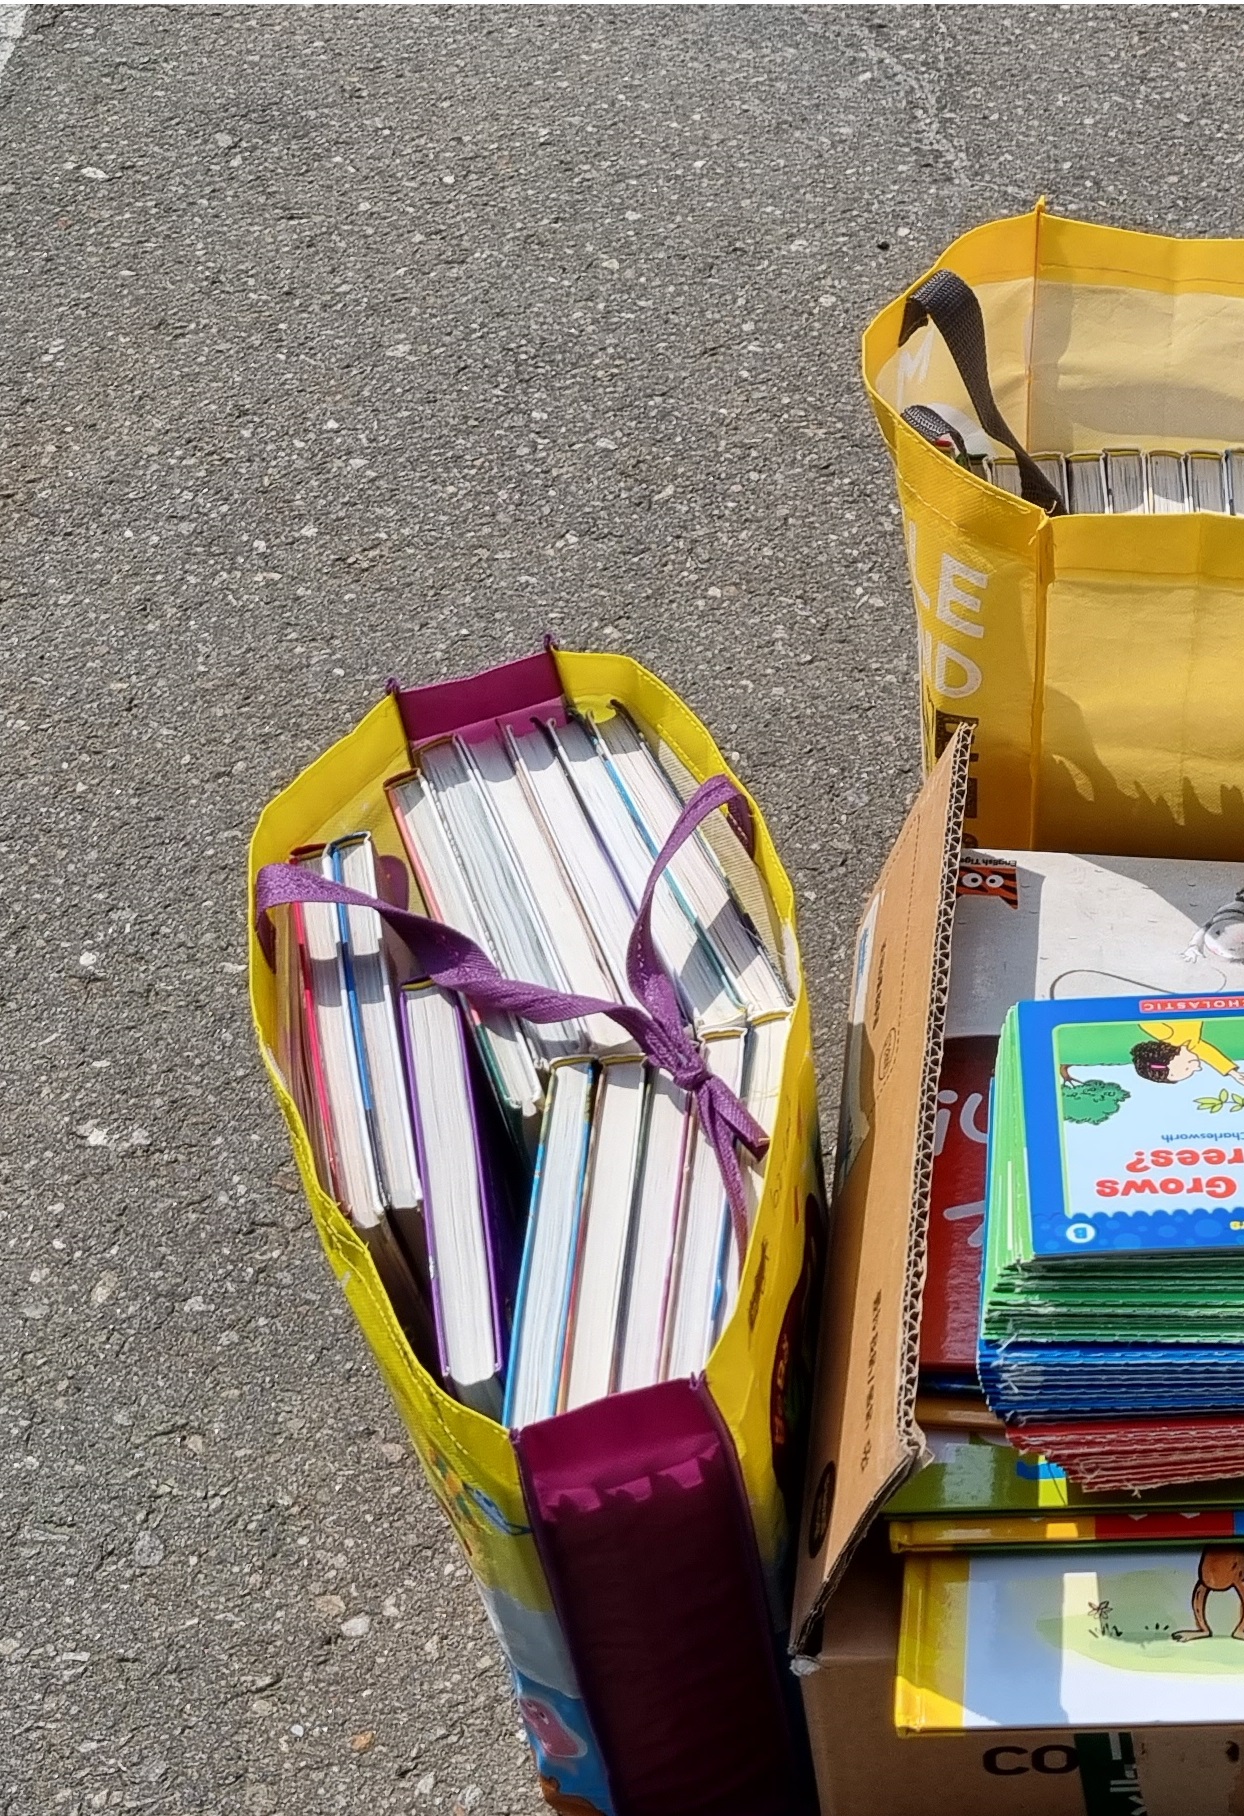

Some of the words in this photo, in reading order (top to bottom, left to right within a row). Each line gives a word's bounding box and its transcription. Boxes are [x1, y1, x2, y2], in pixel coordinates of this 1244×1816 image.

[982, 858, 1016, 867] English
[1095, 1175, 1238, 1201] Grows
[1071, 1225, 1090, 1241] B
